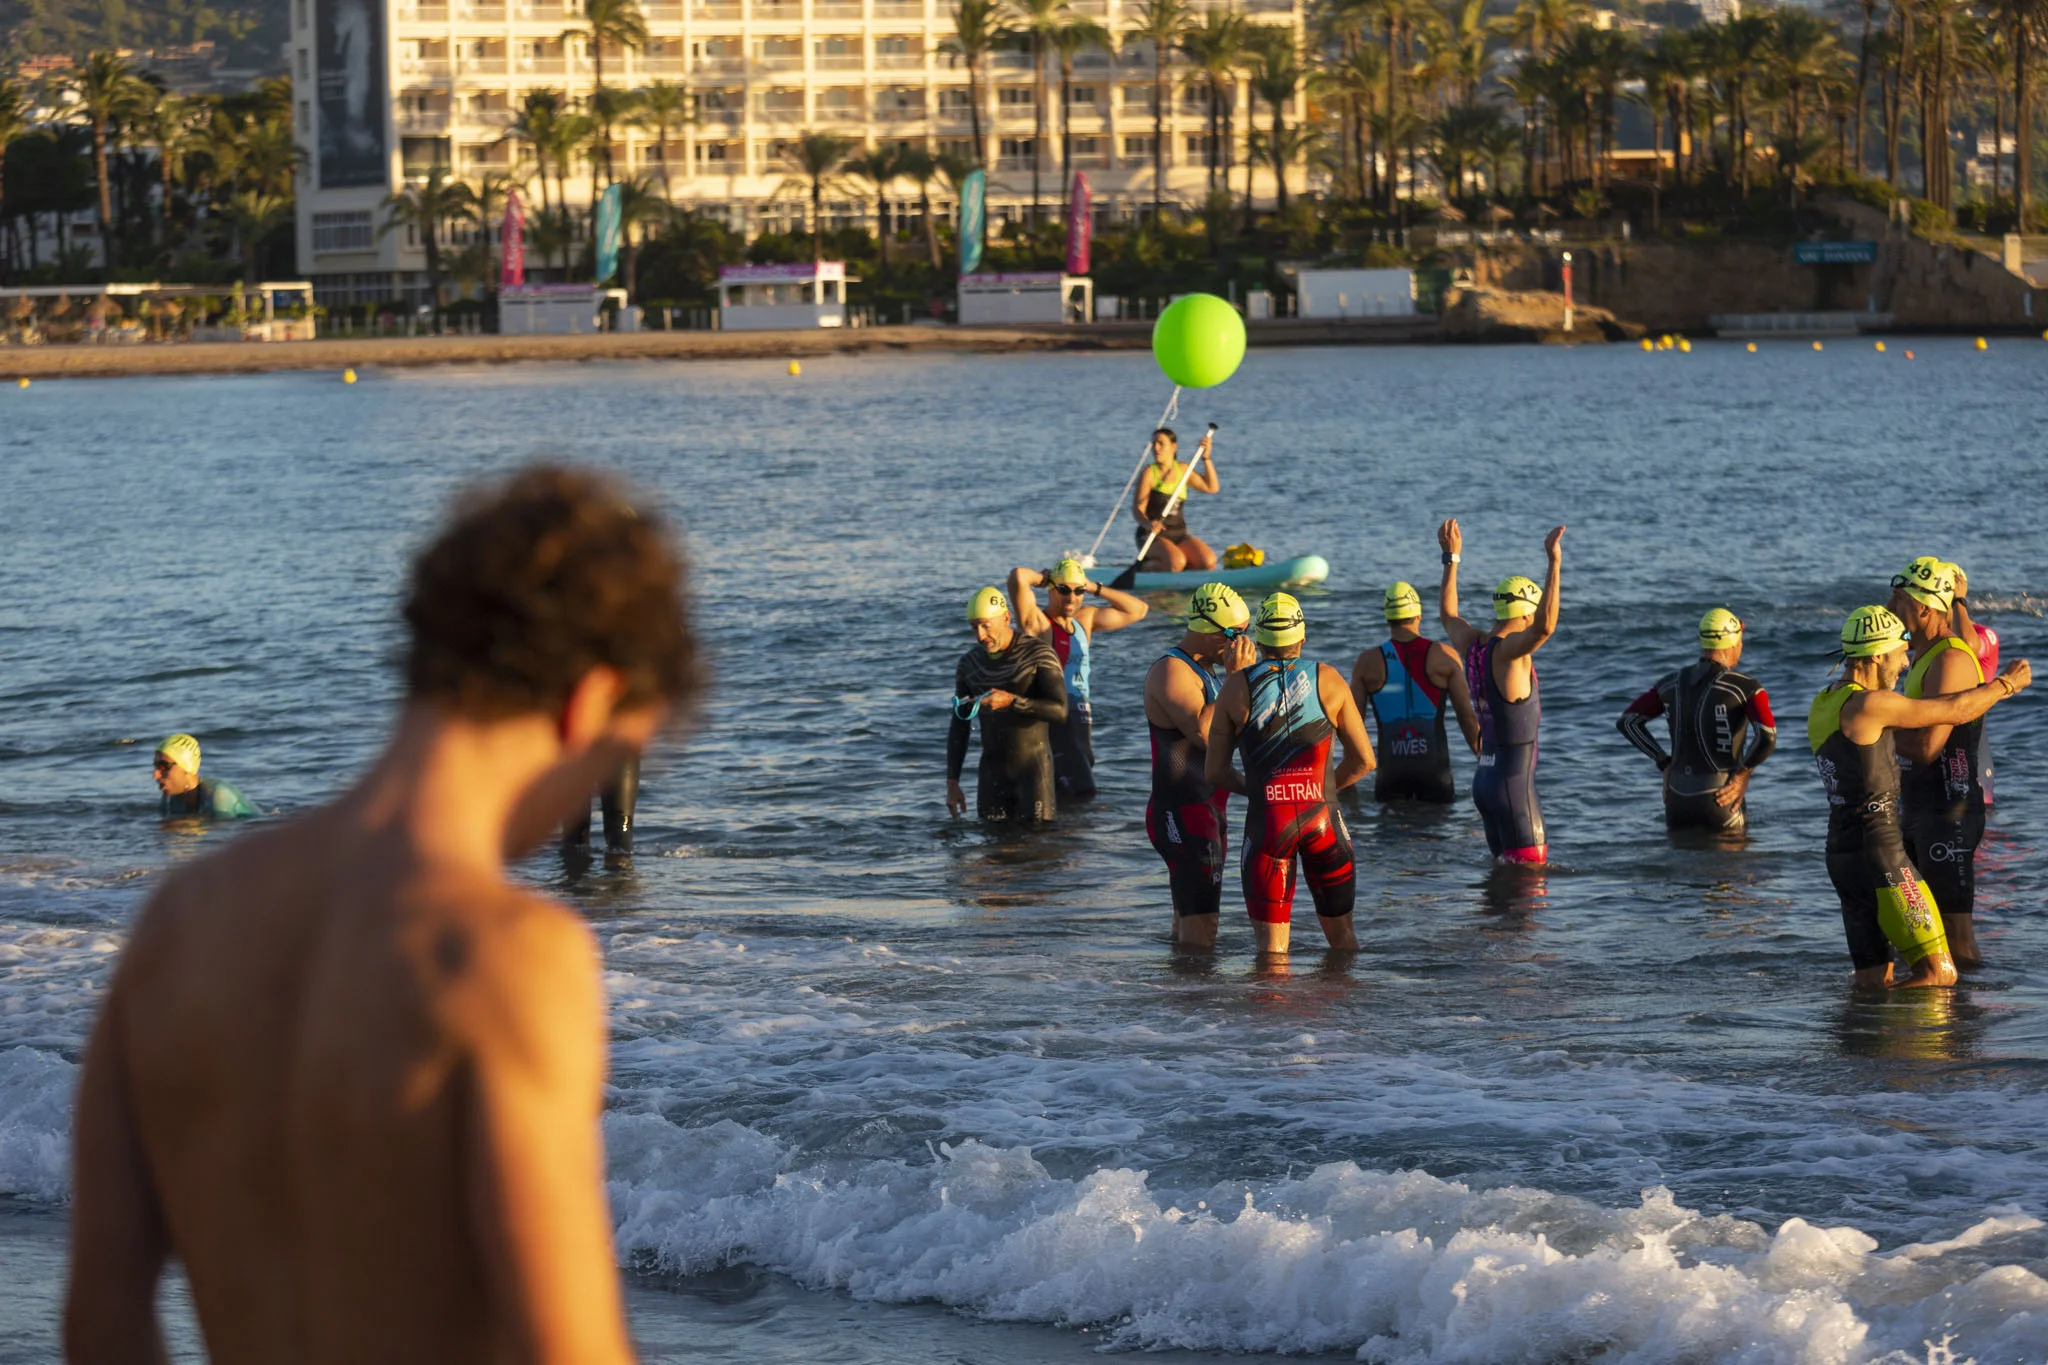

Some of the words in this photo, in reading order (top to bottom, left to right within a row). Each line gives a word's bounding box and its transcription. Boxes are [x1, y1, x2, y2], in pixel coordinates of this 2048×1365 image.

[1714, 704, 1731, 753] HUUB
[1391, 738, 1429, 756] VIVES
[1265, 779, 1323, 801] BELTRÁN
[1899, 881, 1918, 908] BIKE
